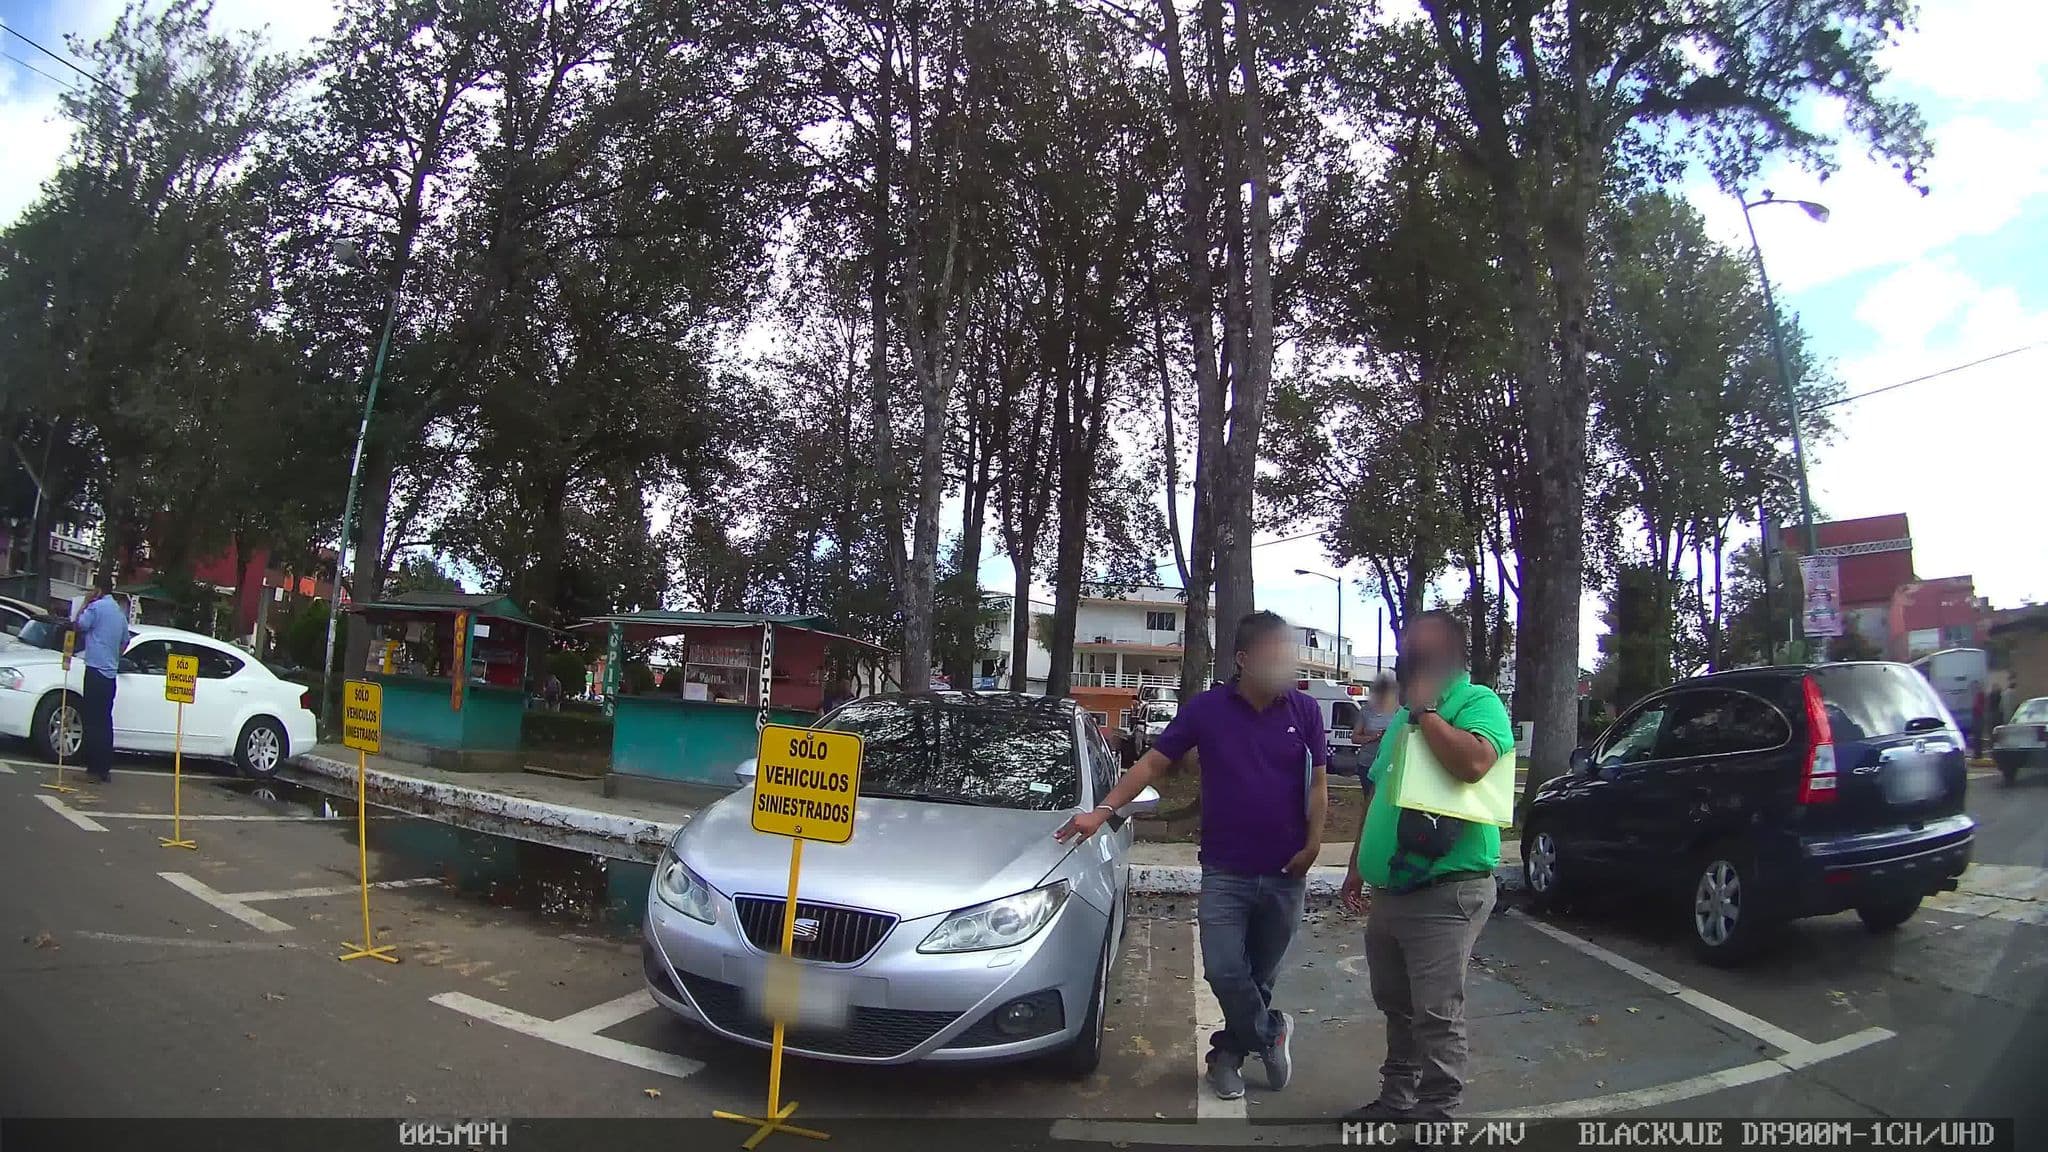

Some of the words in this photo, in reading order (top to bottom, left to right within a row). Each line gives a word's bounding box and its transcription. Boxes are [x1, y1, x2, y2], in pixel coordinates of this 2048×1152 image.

[355, 688, 369, 702] SOLO
[347, 707, 376, 723] VEHICULOS
[790, 739, 827, 760] SOLO
[765, 765, 849, 792] VEHICULOS
[758, 793, 849, 823] SINIESTRADOS
